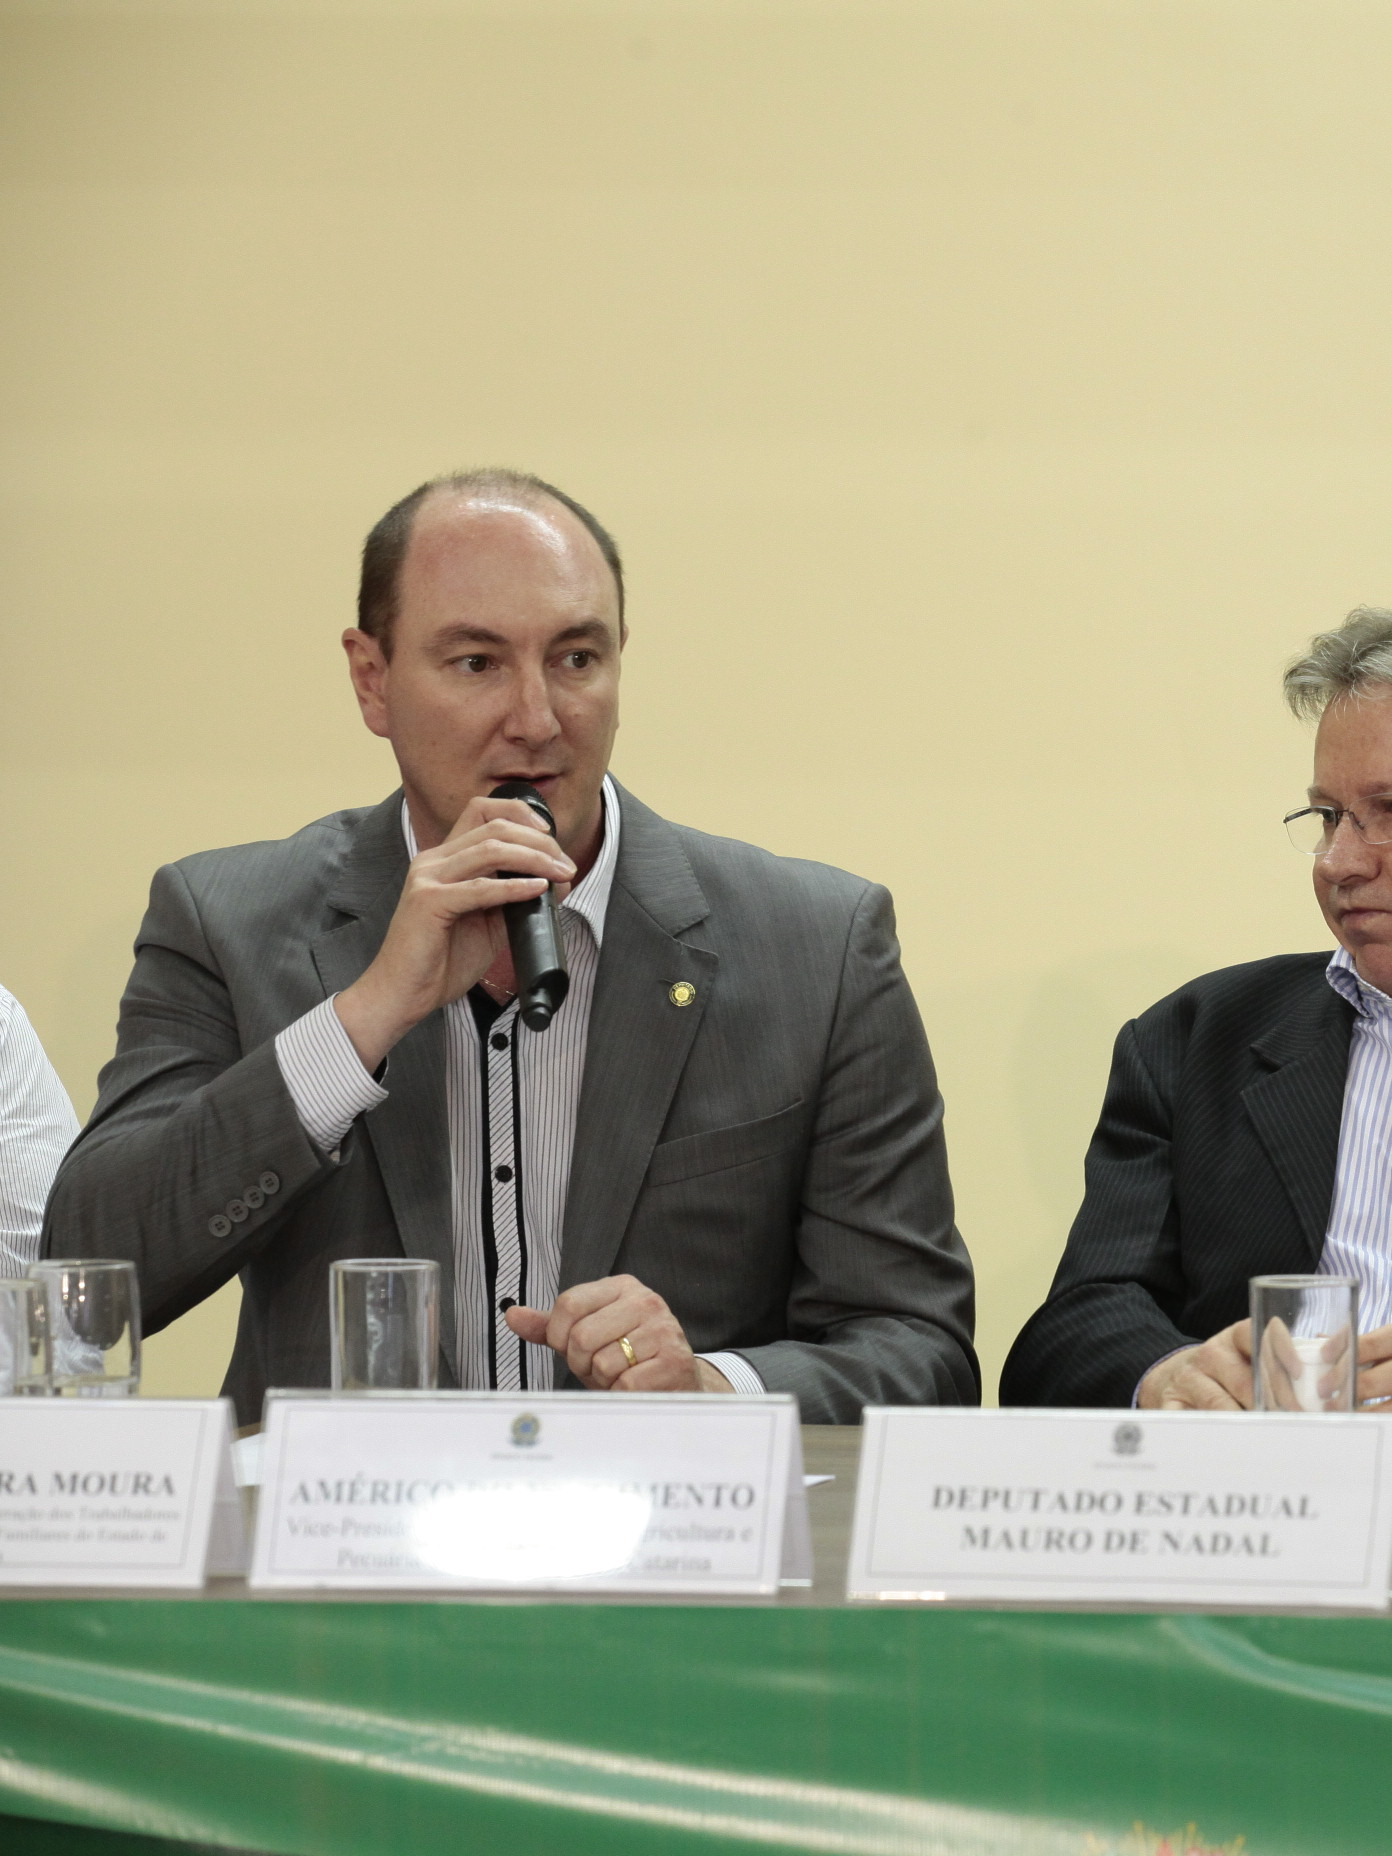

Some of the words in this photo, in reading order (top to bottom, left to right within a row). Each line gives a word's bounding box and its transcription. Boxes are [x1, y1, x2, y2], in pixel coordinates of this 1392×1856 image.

[49, 1471, 176, 1497] MOURA
[288, 1471, 456, 1506] AMÉRICO
[931, 1484, 1123, 1516] DEPUTADO
[1133, 1490, 1320, 1521] ESTADUAL
[641, 1523, 736, 1544] gricultura
[958, 1525, 1092, 1554] MAURO
[1102, 1528, 1149, 1556] DE
[1157, 1529, 1282, 1558] NADAL
